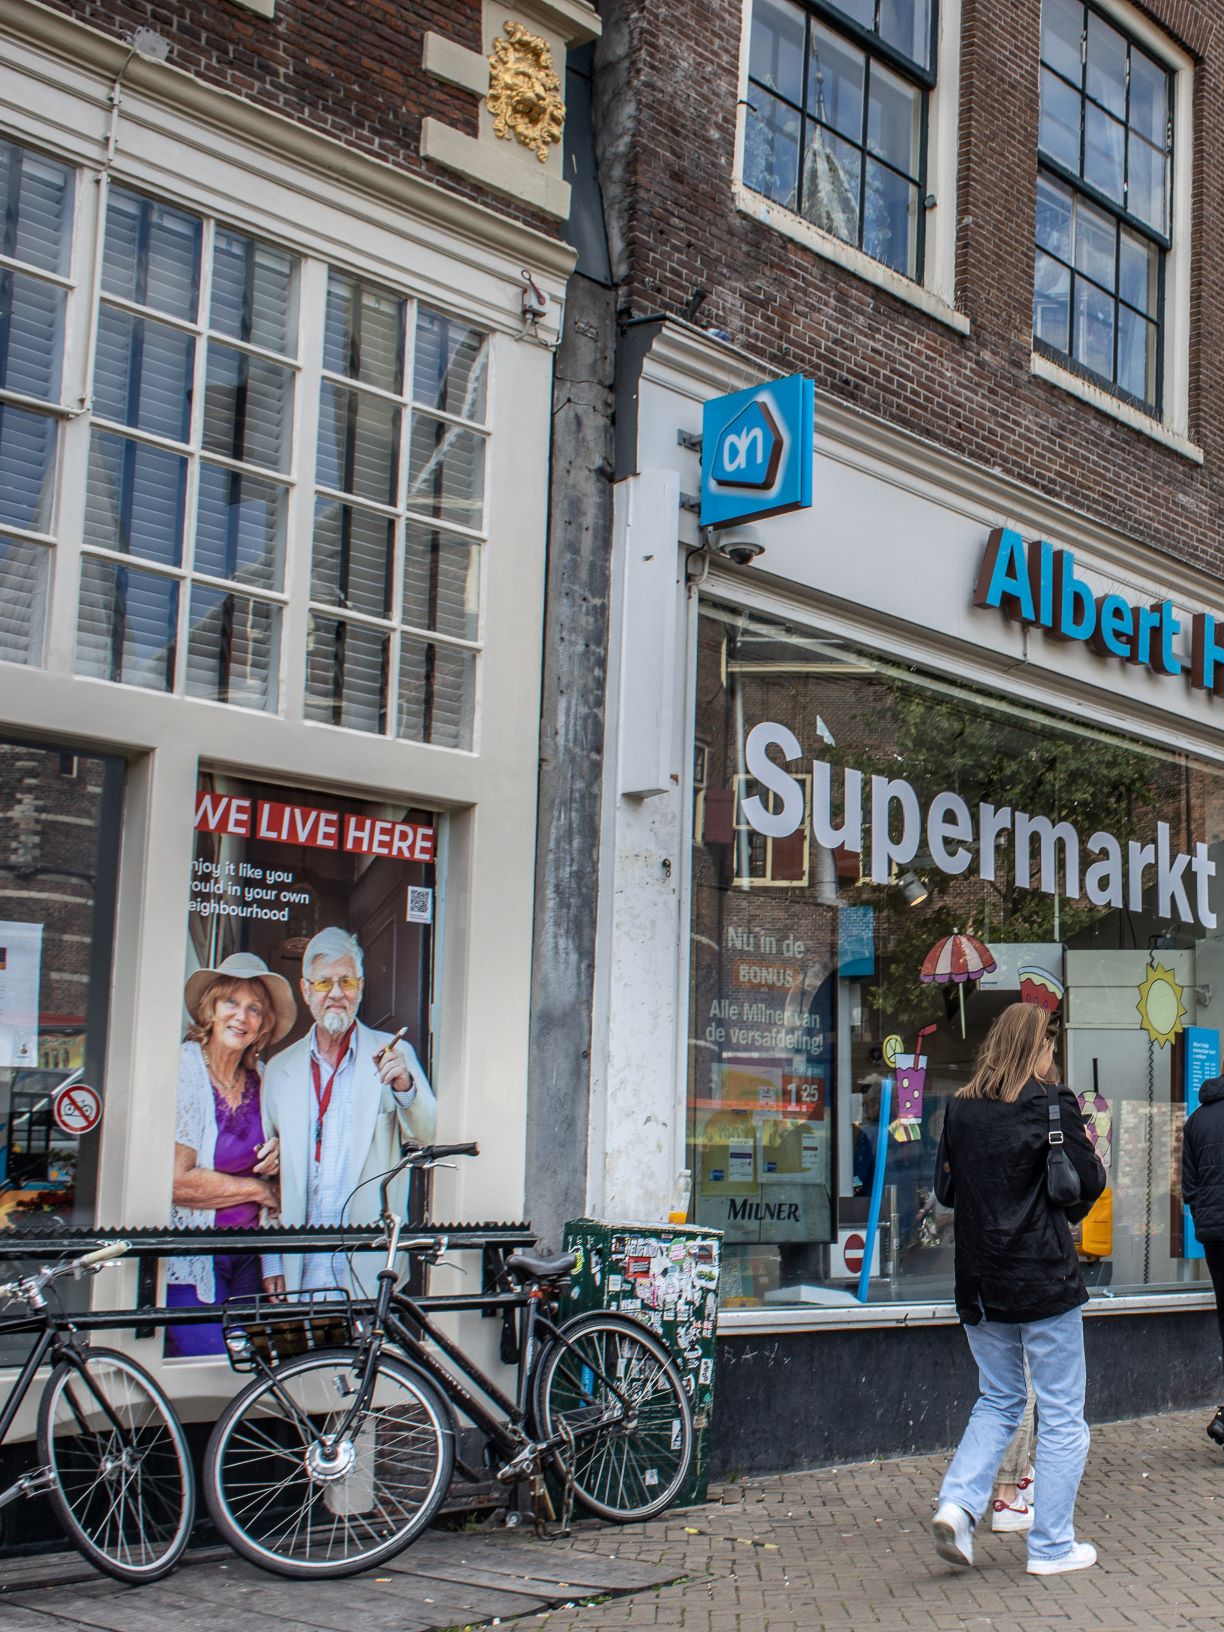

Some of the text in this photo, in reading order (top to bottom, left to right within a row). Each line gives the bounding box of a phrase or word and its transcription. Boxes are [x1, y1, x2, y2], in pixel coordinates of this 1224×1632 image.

[975, 528, 1182, 676] Albert
[193, 794, 434, 861] WE LIVE HERE
[741, 721, 1217, 929] Supermarkt
[191, 857, 292, 885] njoy it like you
[191, 878, 310, 905] ould in your own
[188, 897, 289, 922] eighbourhood
[727, 926, 805, 958] Nu in de
[739, 963, 793, 988] BONUS
[709, 1000, 820, 1029] Alle Milner van
[705, 1022, 824, 1055] de versafdeling!
[727, 1198, 801, 1223] MILNER
